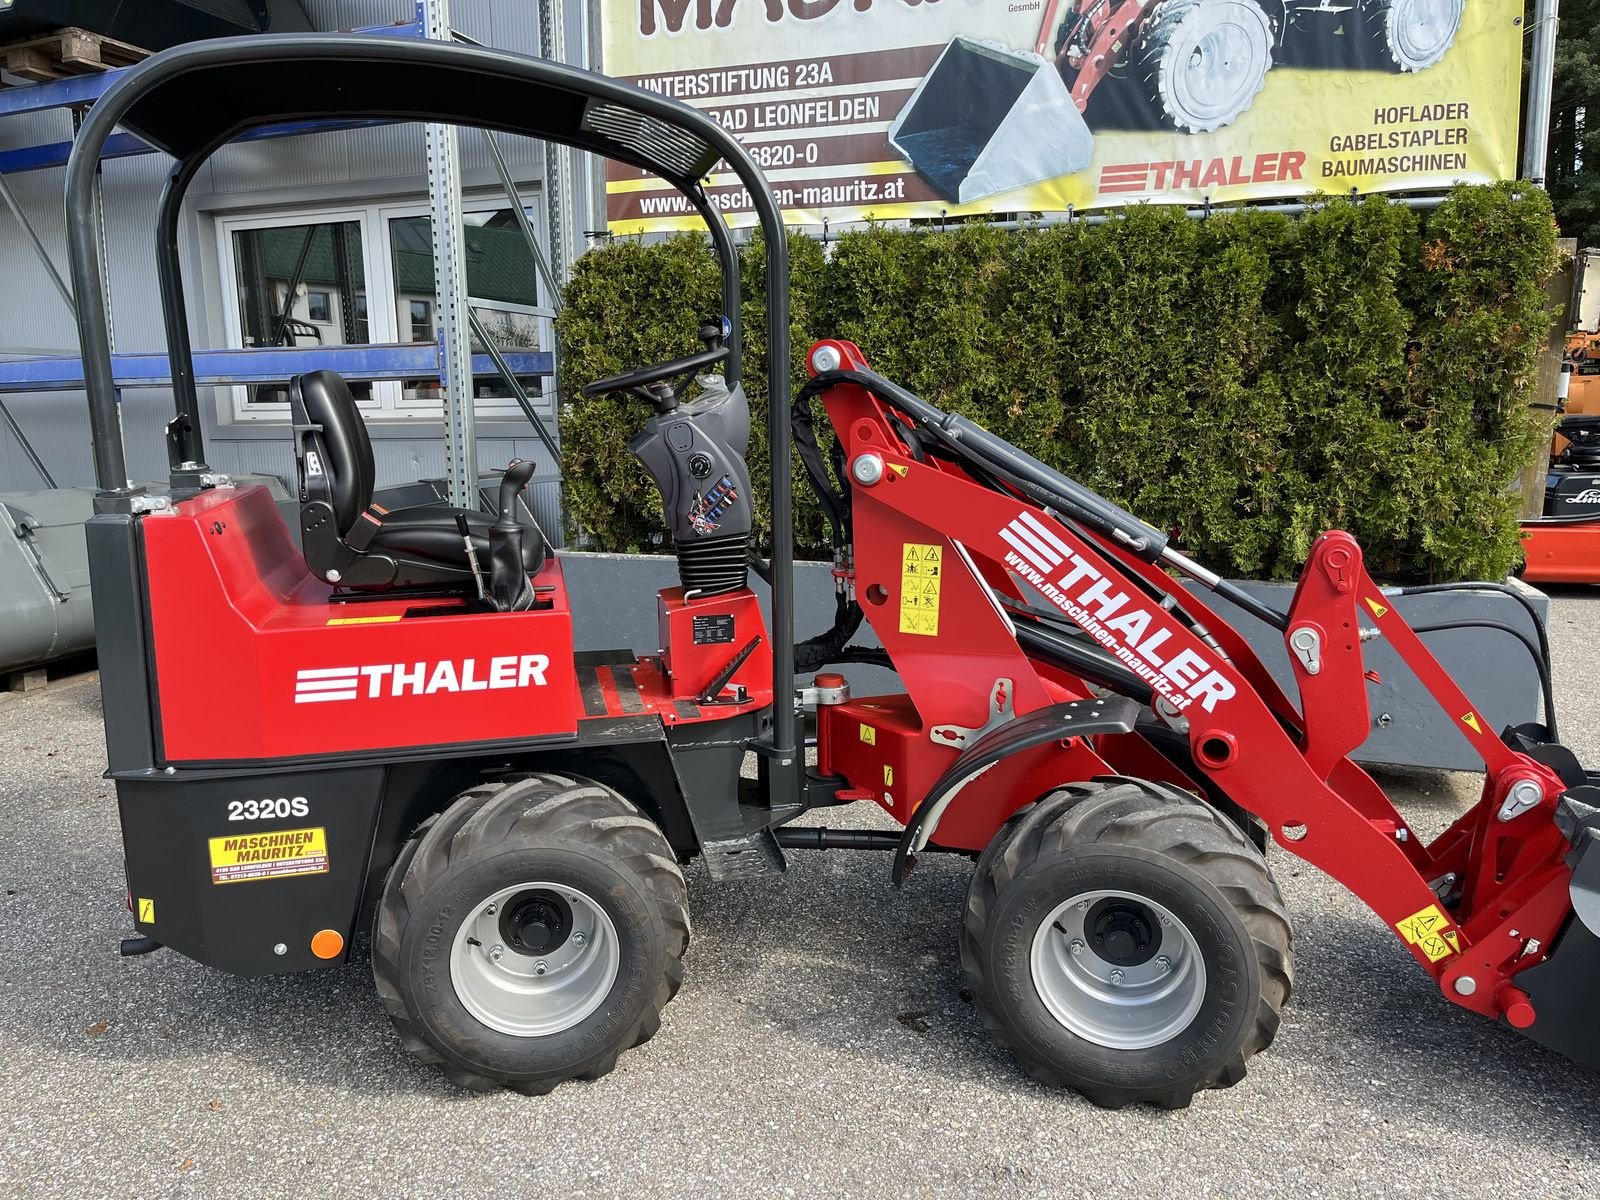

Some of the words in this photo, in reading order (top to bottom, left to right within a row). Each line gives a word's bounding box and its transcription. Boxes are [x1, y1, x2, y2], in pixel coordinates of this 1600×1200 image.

[1008, 1, 1040, 13] GesmbH
[794, 61, 833, 87] 23A
[753, 96, 880, 129] LEONFELDEN
[1374, 103, 1469, 126] HOFLADER
[1330, 128, 1468, 153] GABELSTAPLER
[1149, 150, 1306, 191] THALER
[1321, 153, 1467, 178] BAUMASCHINEN
[1003, 550, 1193, 711] www.maschinen-mauritz.at
[1057, 553, 1237, 714] THALER
[360, 653, 550, 699] THALER
[228, 796, 309, 821] 2320S
[224, 831, 314, 851] MASCHINEN
[236, 845, 304, 863] MAURITZ
